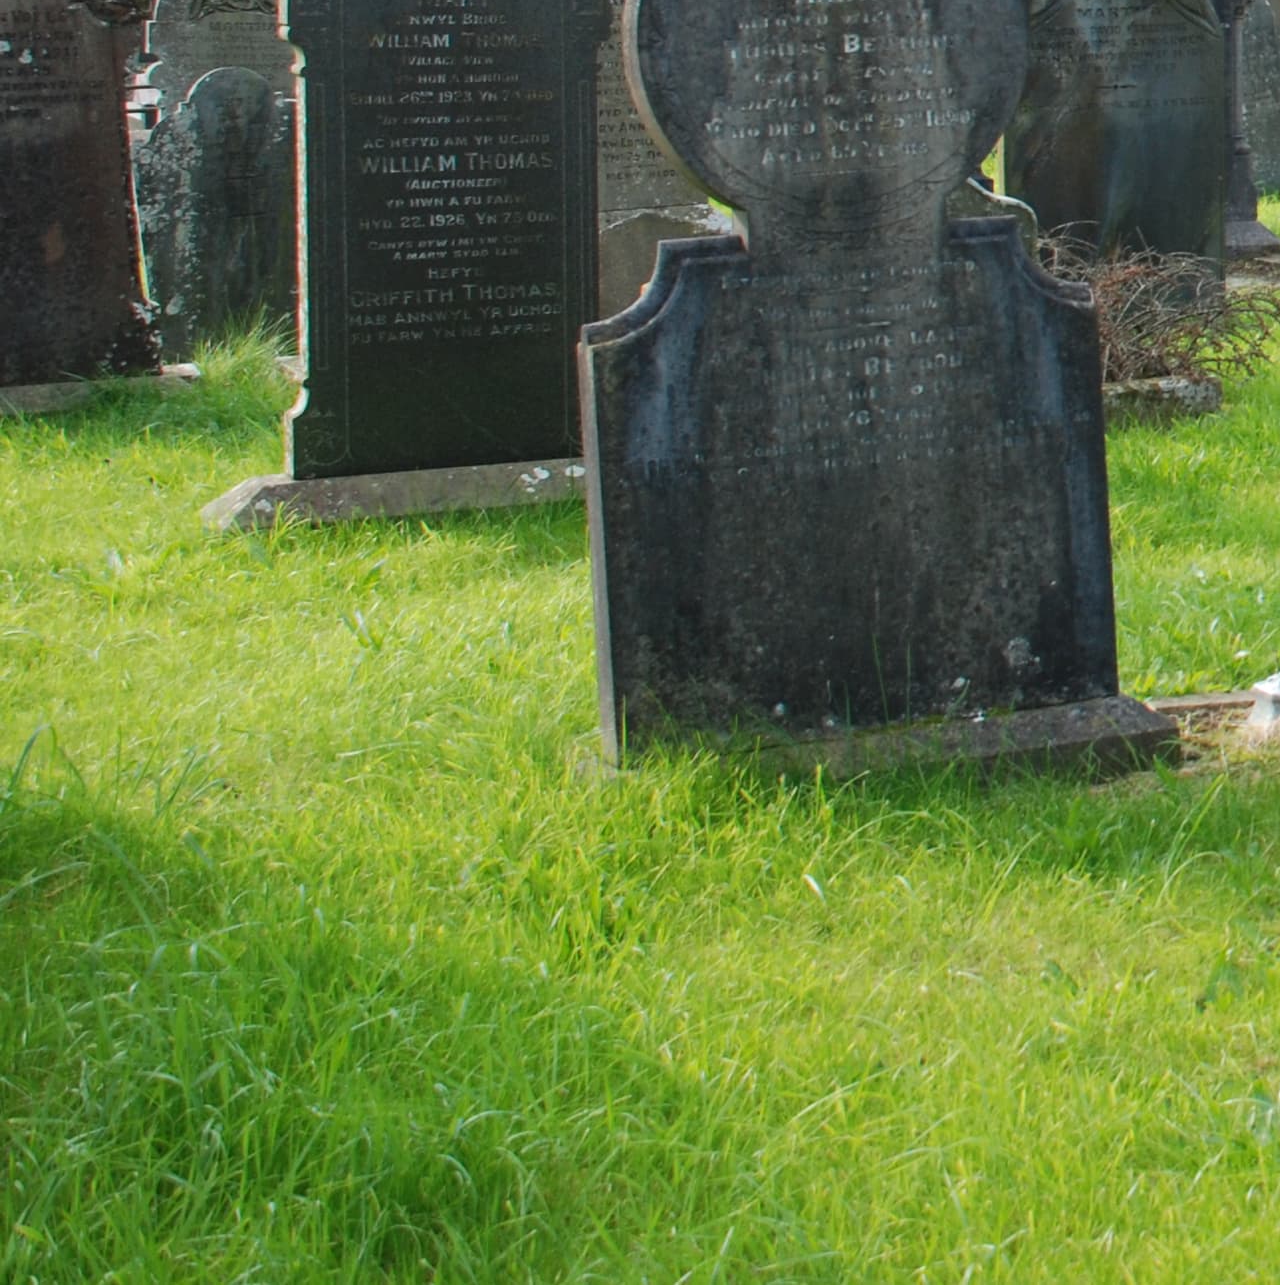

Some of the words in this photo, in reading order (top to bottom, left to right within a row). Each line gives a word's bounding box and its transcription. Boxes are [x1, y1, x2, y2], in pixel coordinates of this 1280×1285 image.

[369, 33, 451, 49] WILLIAM
[444, 135, 469, 147] AM
[361, 154, 456, 174] WILLIAM
[448, 196, 460, 207] A
[350, 288, 454, 309] GRIFFITH
[349, 313, 387, 327] MAB
[393, 309, 473, 325] ANNWYL
[480, 306, 502, 320] YR
